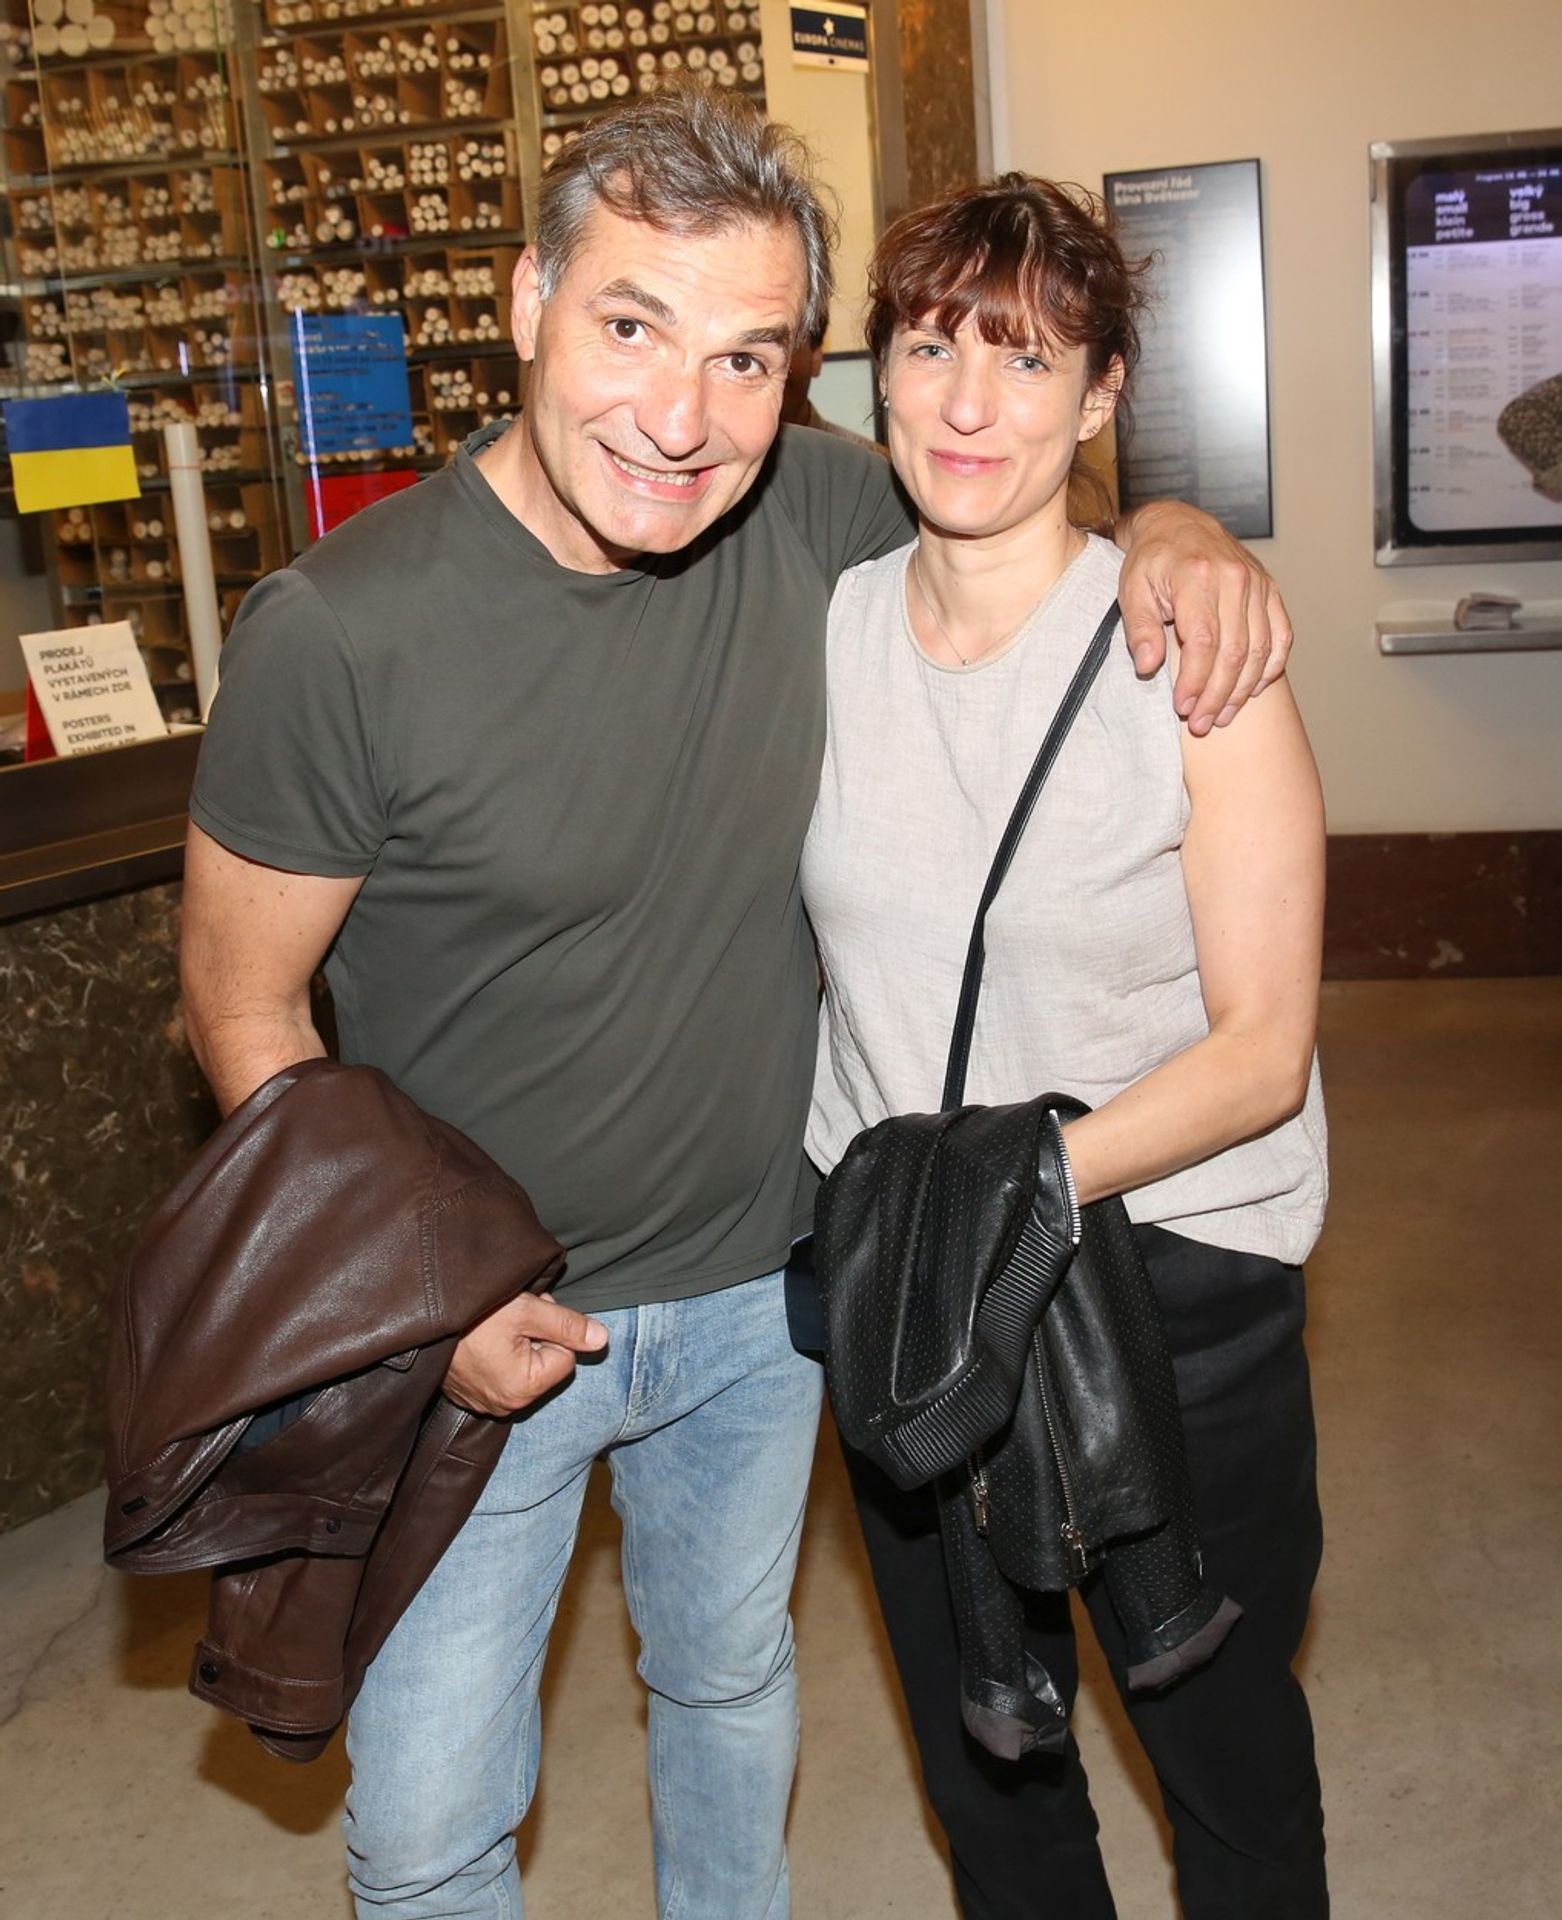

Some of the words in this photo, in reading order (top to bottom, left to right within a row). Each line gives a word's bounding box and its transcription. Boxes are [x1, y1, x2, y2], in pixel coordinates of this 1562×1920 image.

[794, 32, 828, 46] EUROPA
[40, 646, 83, 659] PRODEJ
[44, 657, 94, 674] PLAKÁTŮ
[48, 668, 127, 687] VYSTAVENÝCH
[53, 693, 60, 702] V
[63, 686, 109, 700] RÁMECH
[112, 682, 132, 692] ZDE
[63, 714, 111, 729] POSTERS
[68, 727, 122, 743] EXHIBITED
[124, 724, 136, 732] IN
